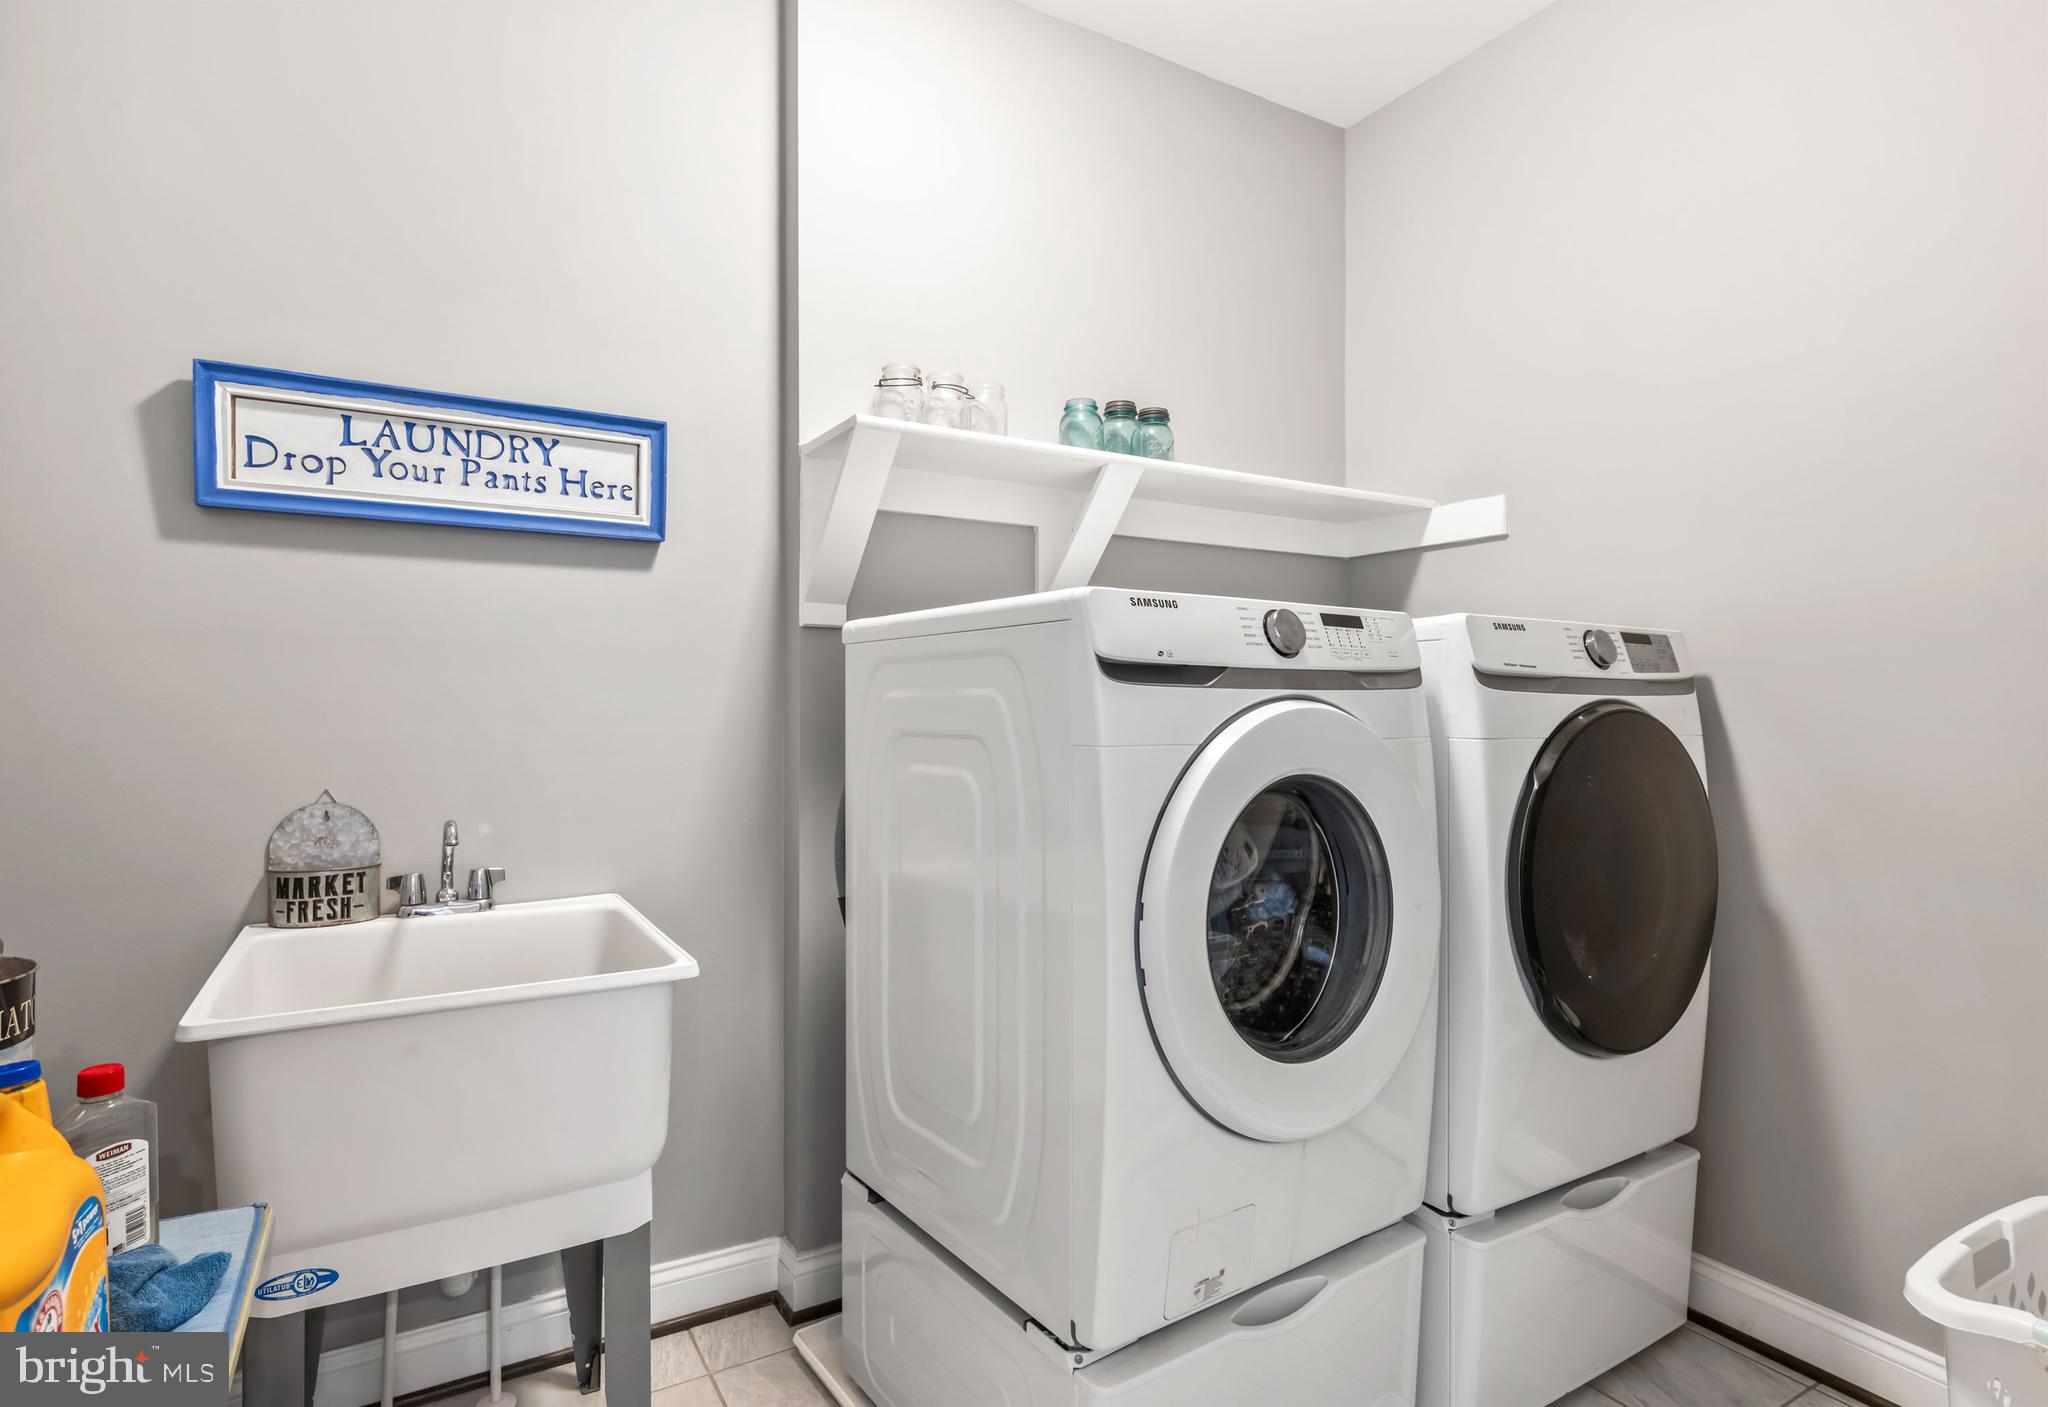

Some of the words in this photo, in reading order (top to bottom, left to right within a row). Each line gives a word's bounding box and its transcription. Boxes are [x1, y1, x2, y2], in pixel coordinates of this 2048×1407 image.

[339, 413, 560, 467] LAUNDRY
[243, 433, 347, 485] Drop
[360, 447, 447, 485] Your
[461, 457, 547, 494] Pants
[560, 467, 633, 501] Here
[1129, 596, 1179, 609] SAMSUNG
[1492, 622, 1526, 632] SAMSUNG
[276, 871, 367, 899] MARKET
[98, 1144, 129, 1160] WEIMAN
